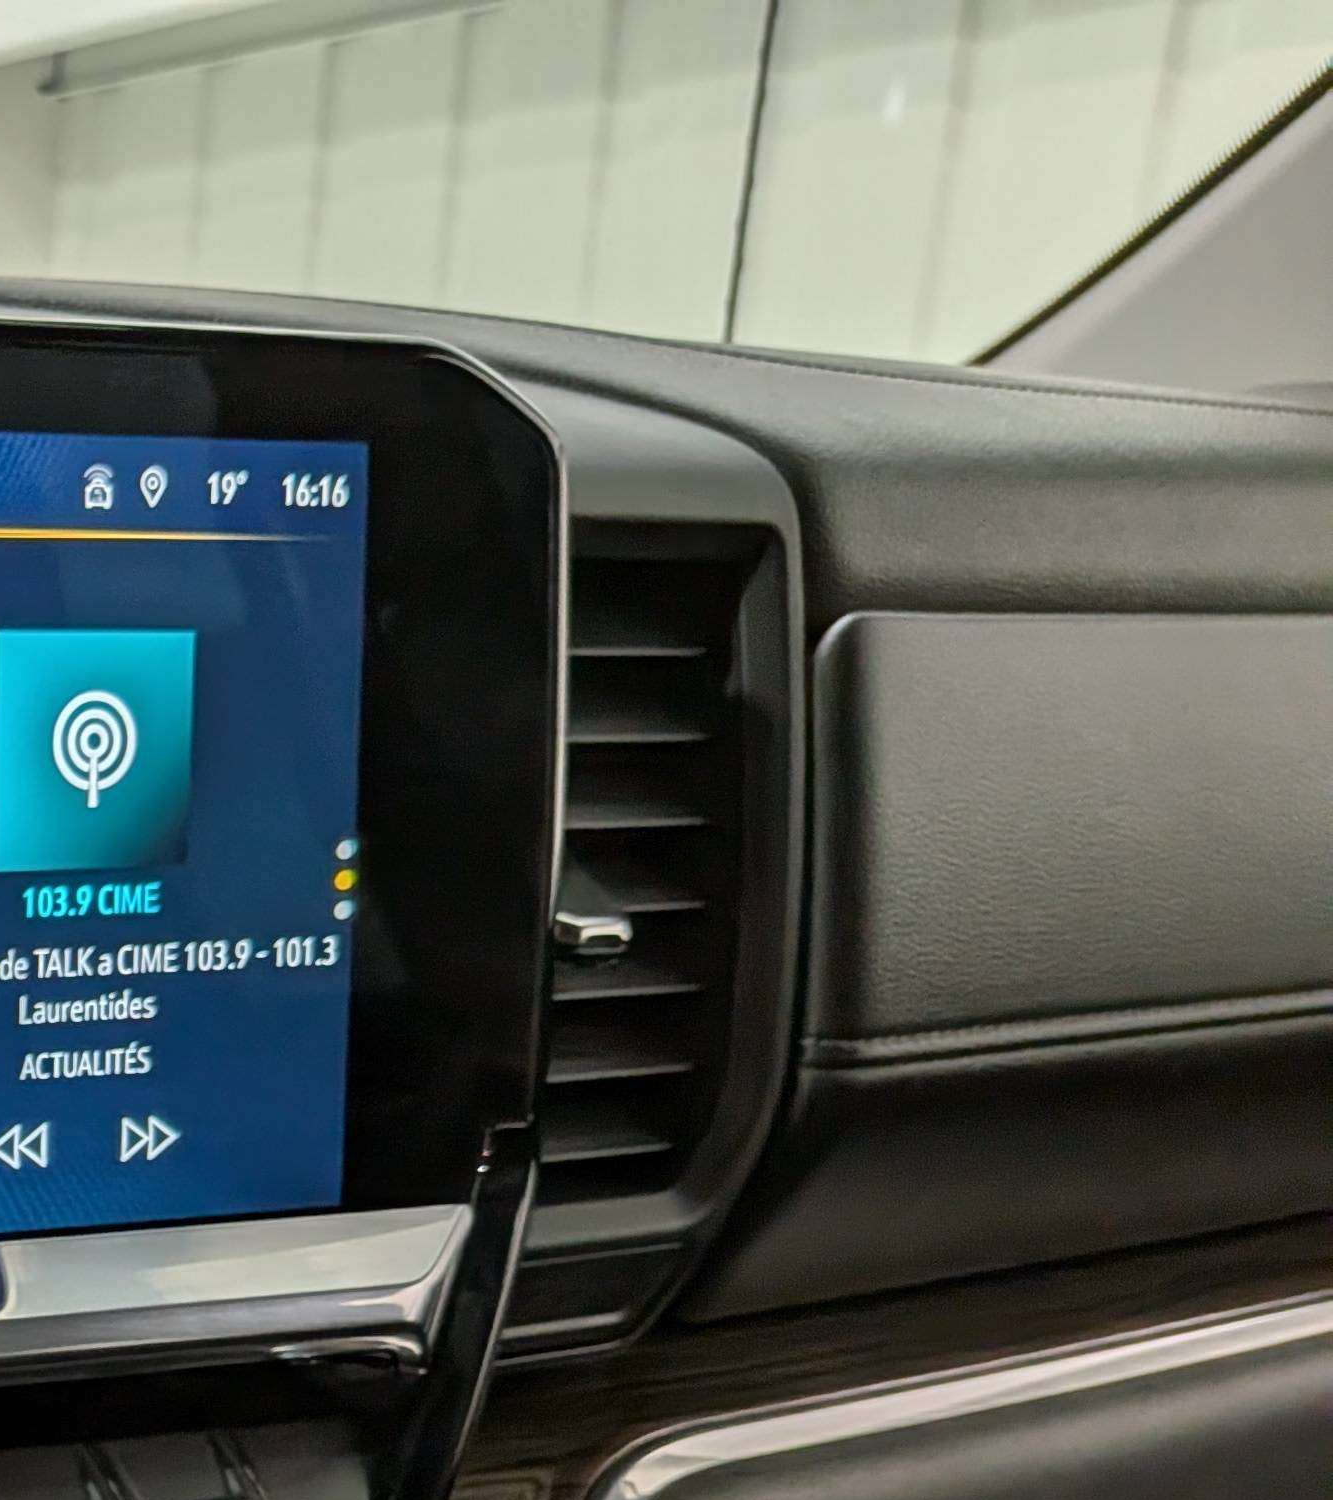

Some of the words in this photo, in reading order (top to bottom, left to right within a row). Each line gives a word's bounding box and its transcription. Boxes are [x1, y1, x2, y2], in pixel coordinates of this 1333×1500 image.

[281, 473, 349, 508] 16:16
[22, 884, 93, 919] 103.9
[97, 881, 162, 916] CIME
[32, 946, 95, 979] TALK
[97, 953, 114, 977] a
[116, 941, 180, 975] CIME
[184, 938, 253, 972] 103.9
[272, 935, 338, 968] 101.3
[18, 988, 158, 1026] Laurentides
[19, 1041, 152, 1081] ACTUALITÉS
